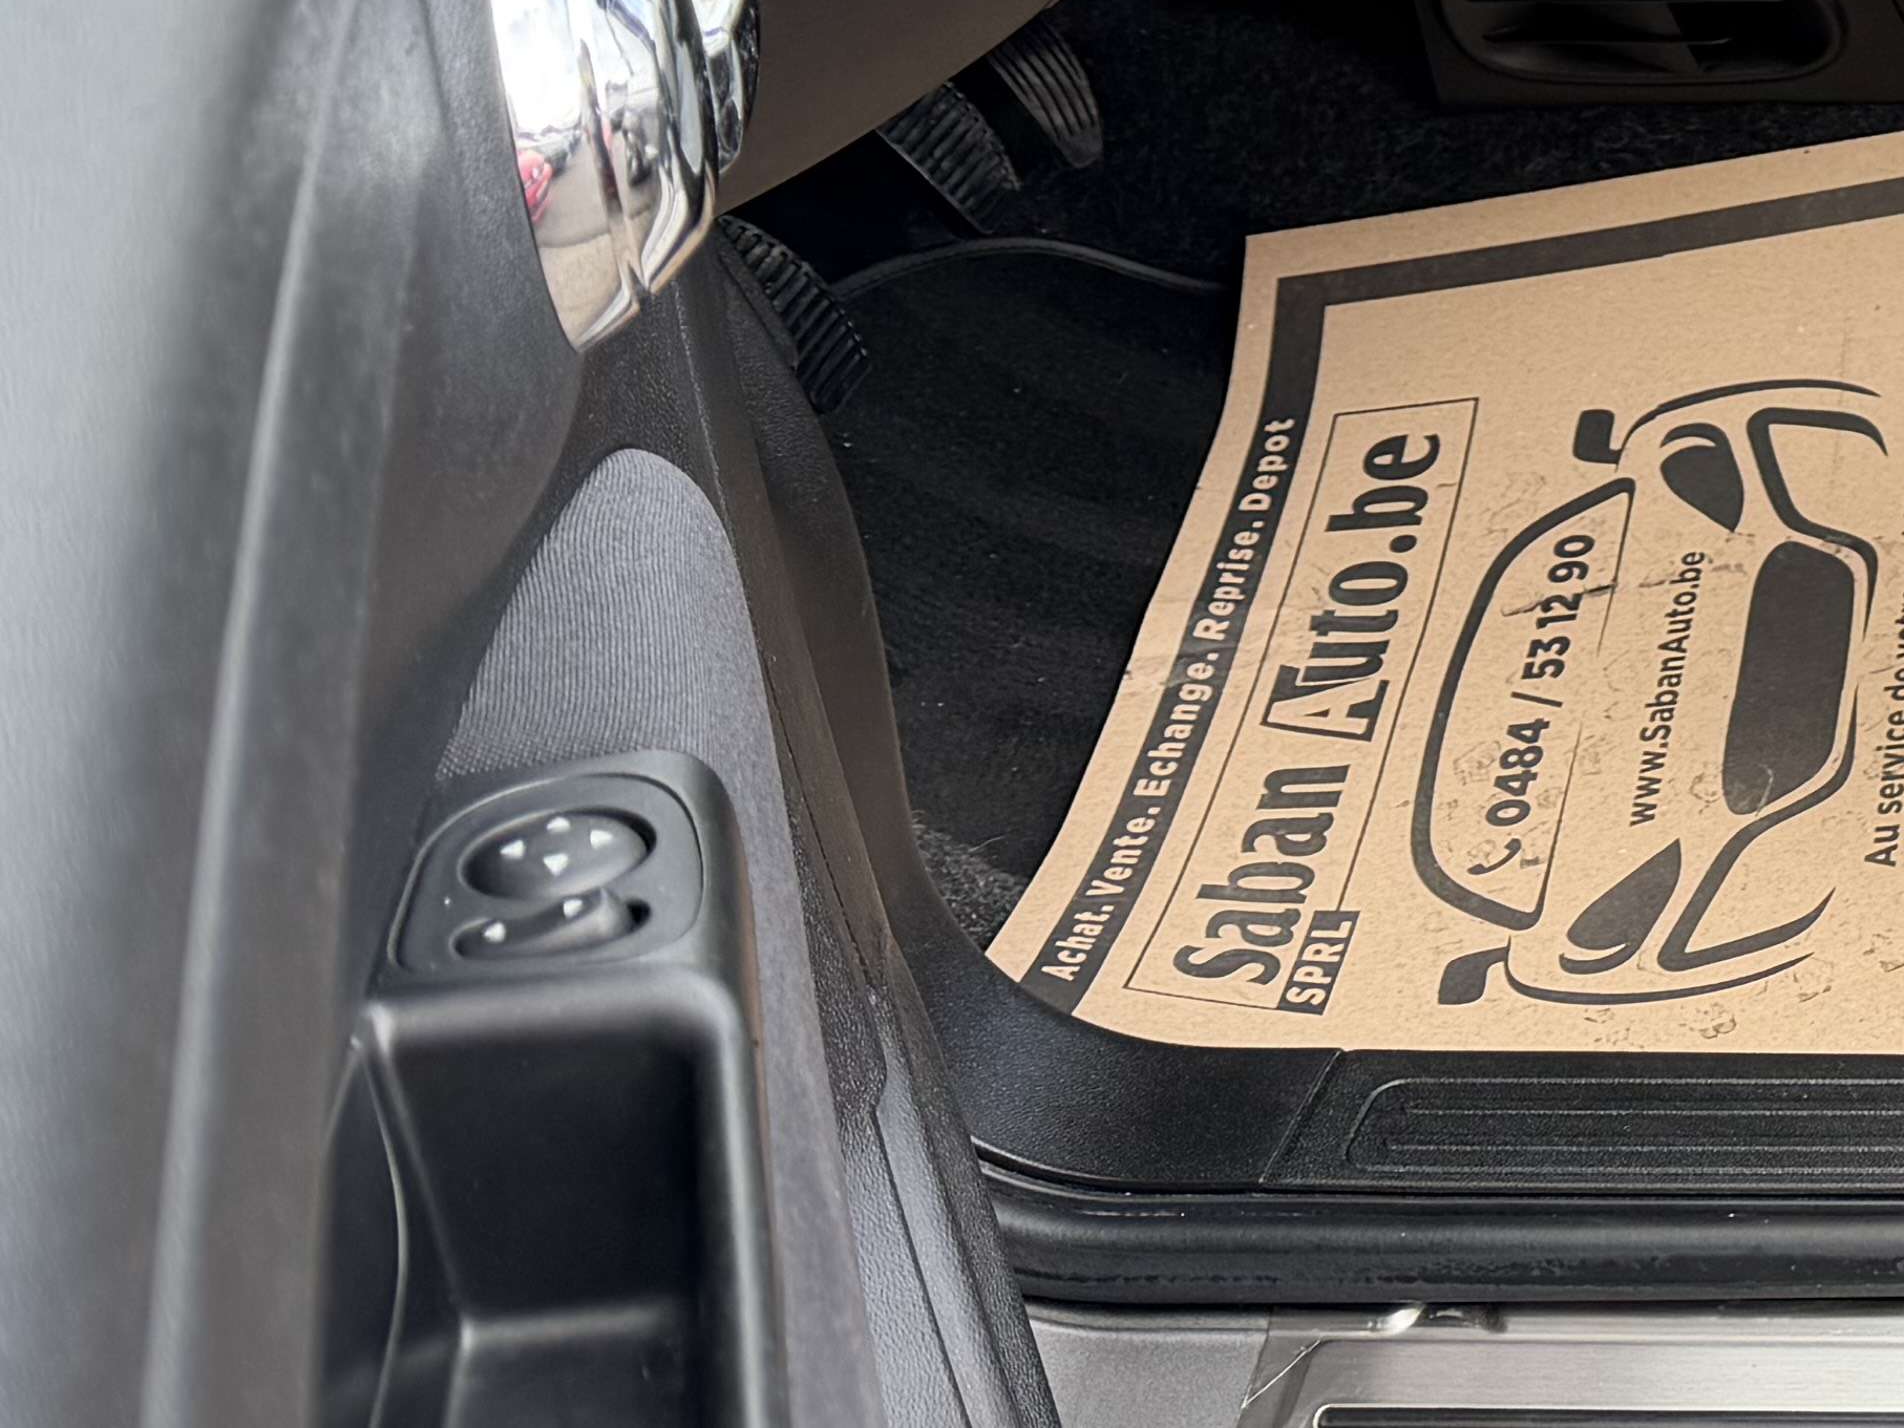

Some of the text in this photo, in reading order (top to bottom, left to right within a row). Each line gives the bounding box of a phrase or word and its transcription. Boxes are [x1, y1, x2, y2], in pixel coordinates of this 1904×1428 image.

[1041, 417, 1296, 982] Achat. Vente. Echange. Reprise. Depot
[1172, 432, 1442, 988] Saban Auto.be
[1485, 534, 1596, 828] 0484 / 53 12 90
[1630, 550, 1706, 828] www.SabanAuto.be
[1285, 918, 1354, 1009] SPRL
[1863, 822, 1901, 868] Au
